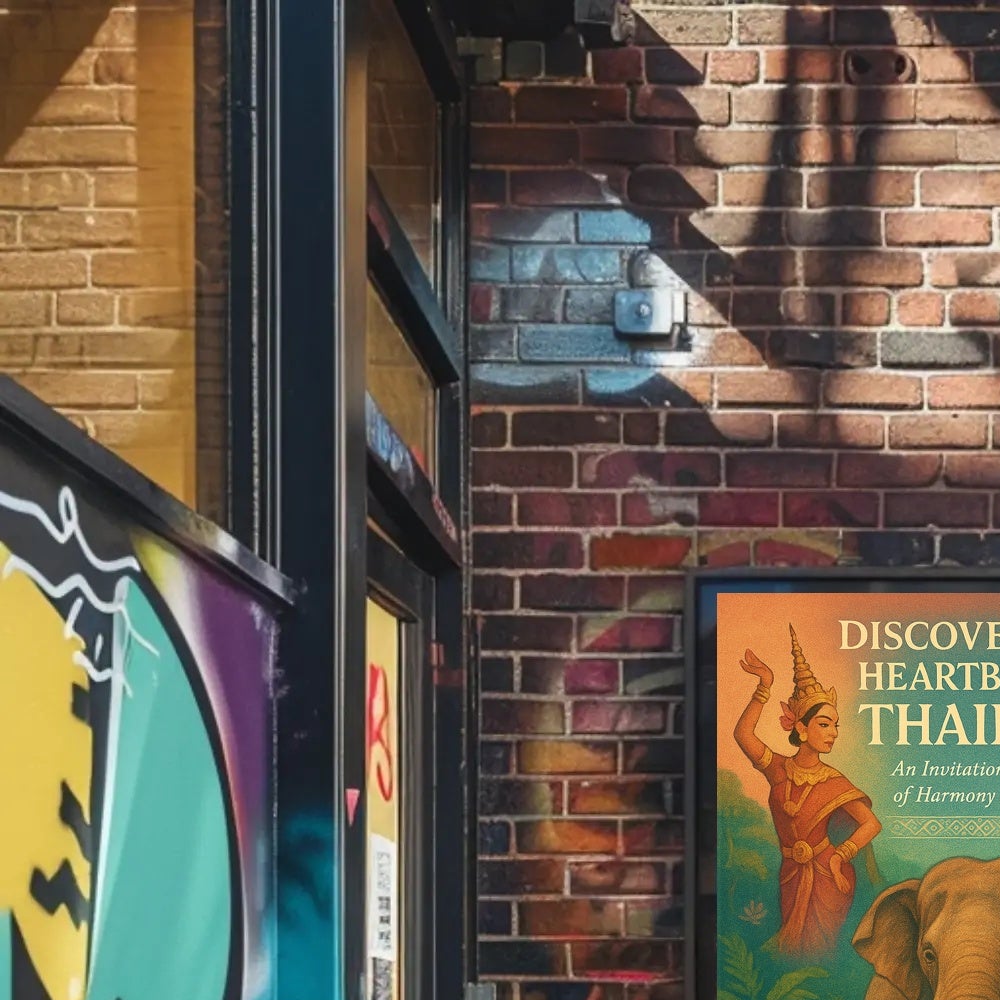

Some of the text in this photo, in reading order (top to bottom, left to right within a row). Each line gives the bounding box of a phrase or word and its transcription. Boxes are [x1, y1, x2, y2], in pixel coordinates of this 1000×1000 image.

[890, 760, 917, 777] An
[892, 785, 912, 809] of
[916, 786, 996, 809] Harmony
